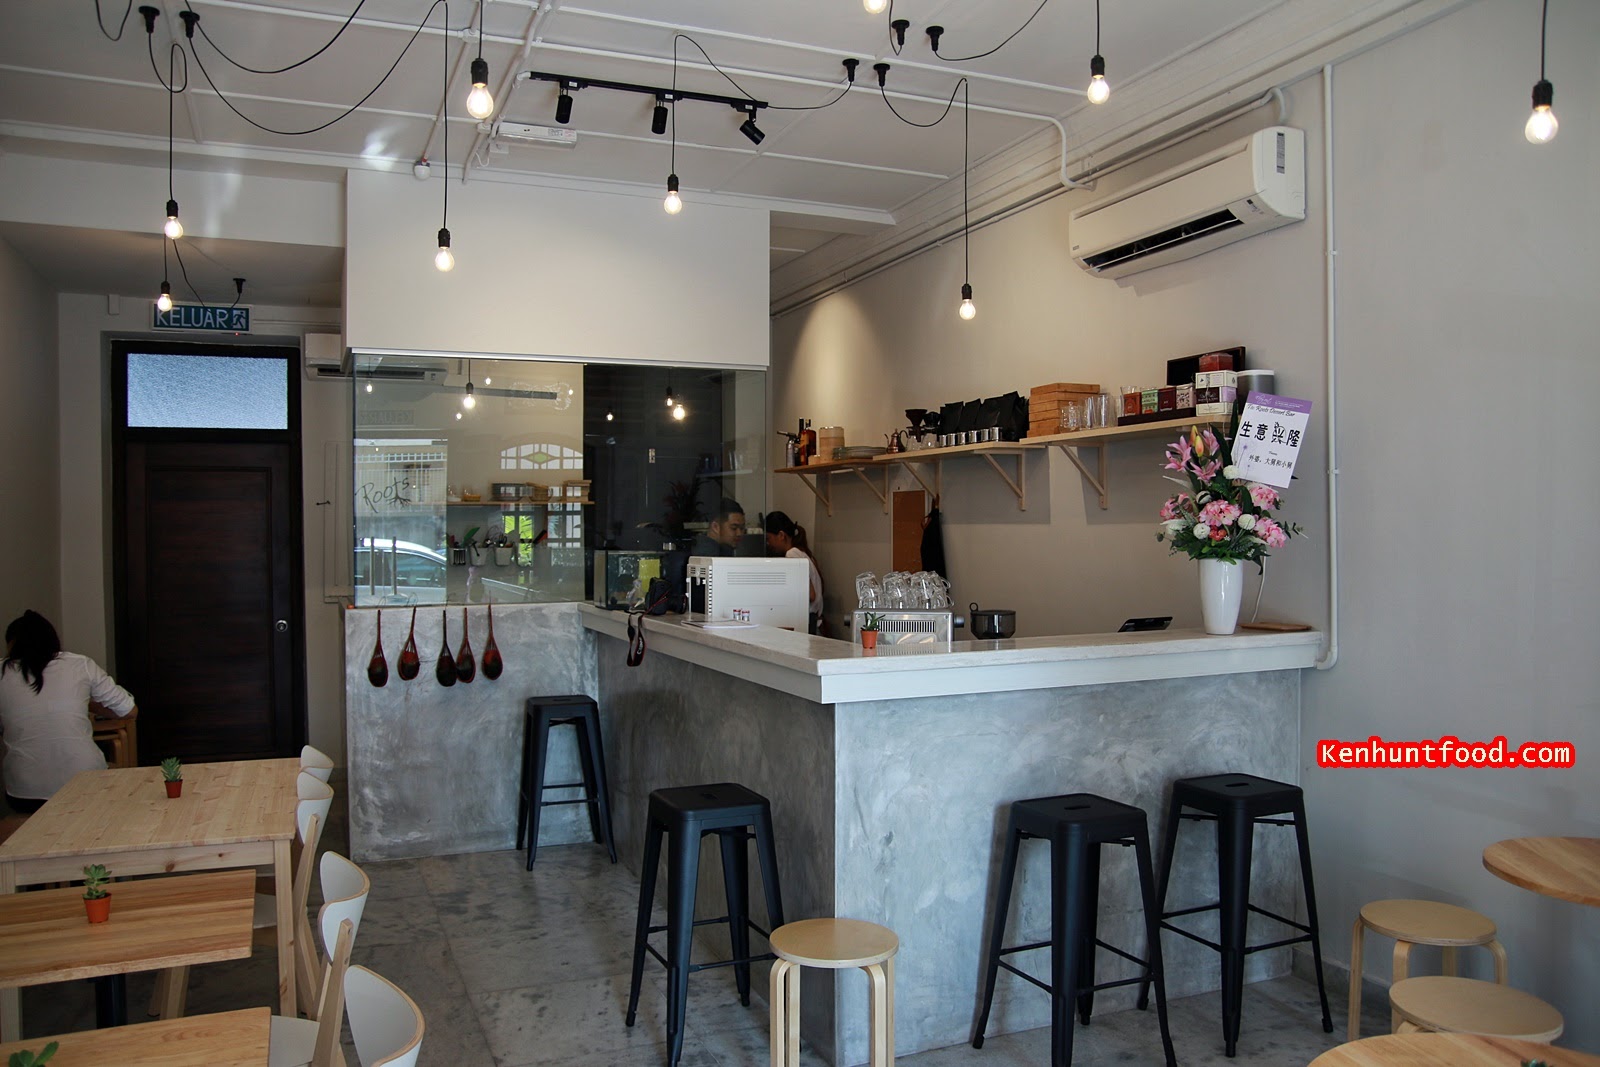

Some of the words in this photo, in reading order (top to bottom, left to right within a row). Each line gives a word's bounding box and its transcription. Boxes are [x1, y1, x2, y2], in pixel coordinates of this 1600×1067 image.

[157, 307, 229, 329] KELUAR
[1240, 421, 1301, 448] 生意兴隆
[354, 476, 411, 514] Roots
